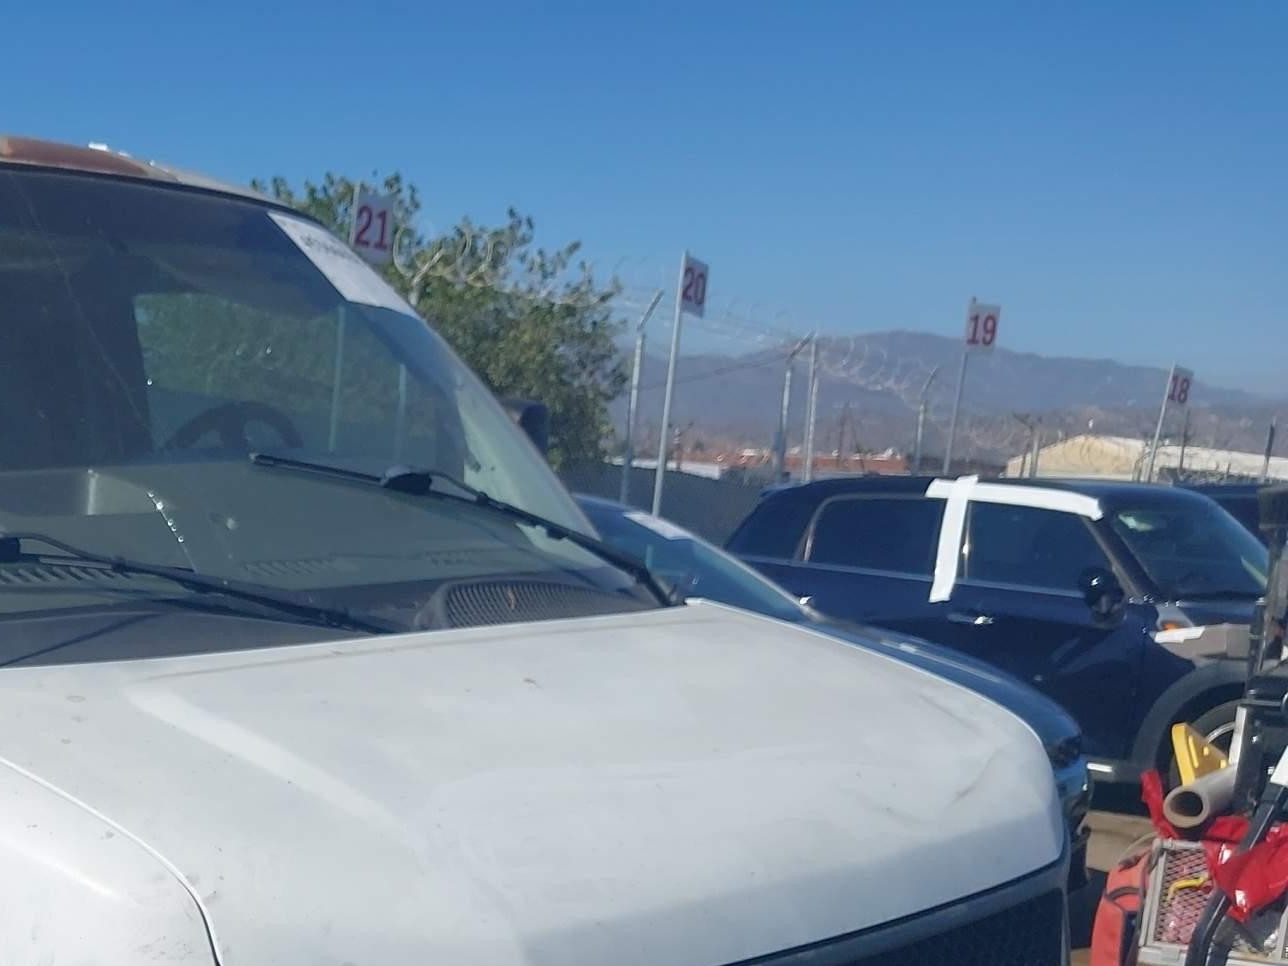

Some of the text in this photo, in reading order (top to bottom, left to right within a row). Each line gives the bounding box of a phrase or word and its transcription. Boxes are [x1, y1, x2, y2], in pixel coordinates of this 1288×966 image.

[354, 205, 388, 250] 21
[681, 267, 706, 306] 20
[967, 314, 997, 346] 19
[1168, 375, 1190, 404] 18
